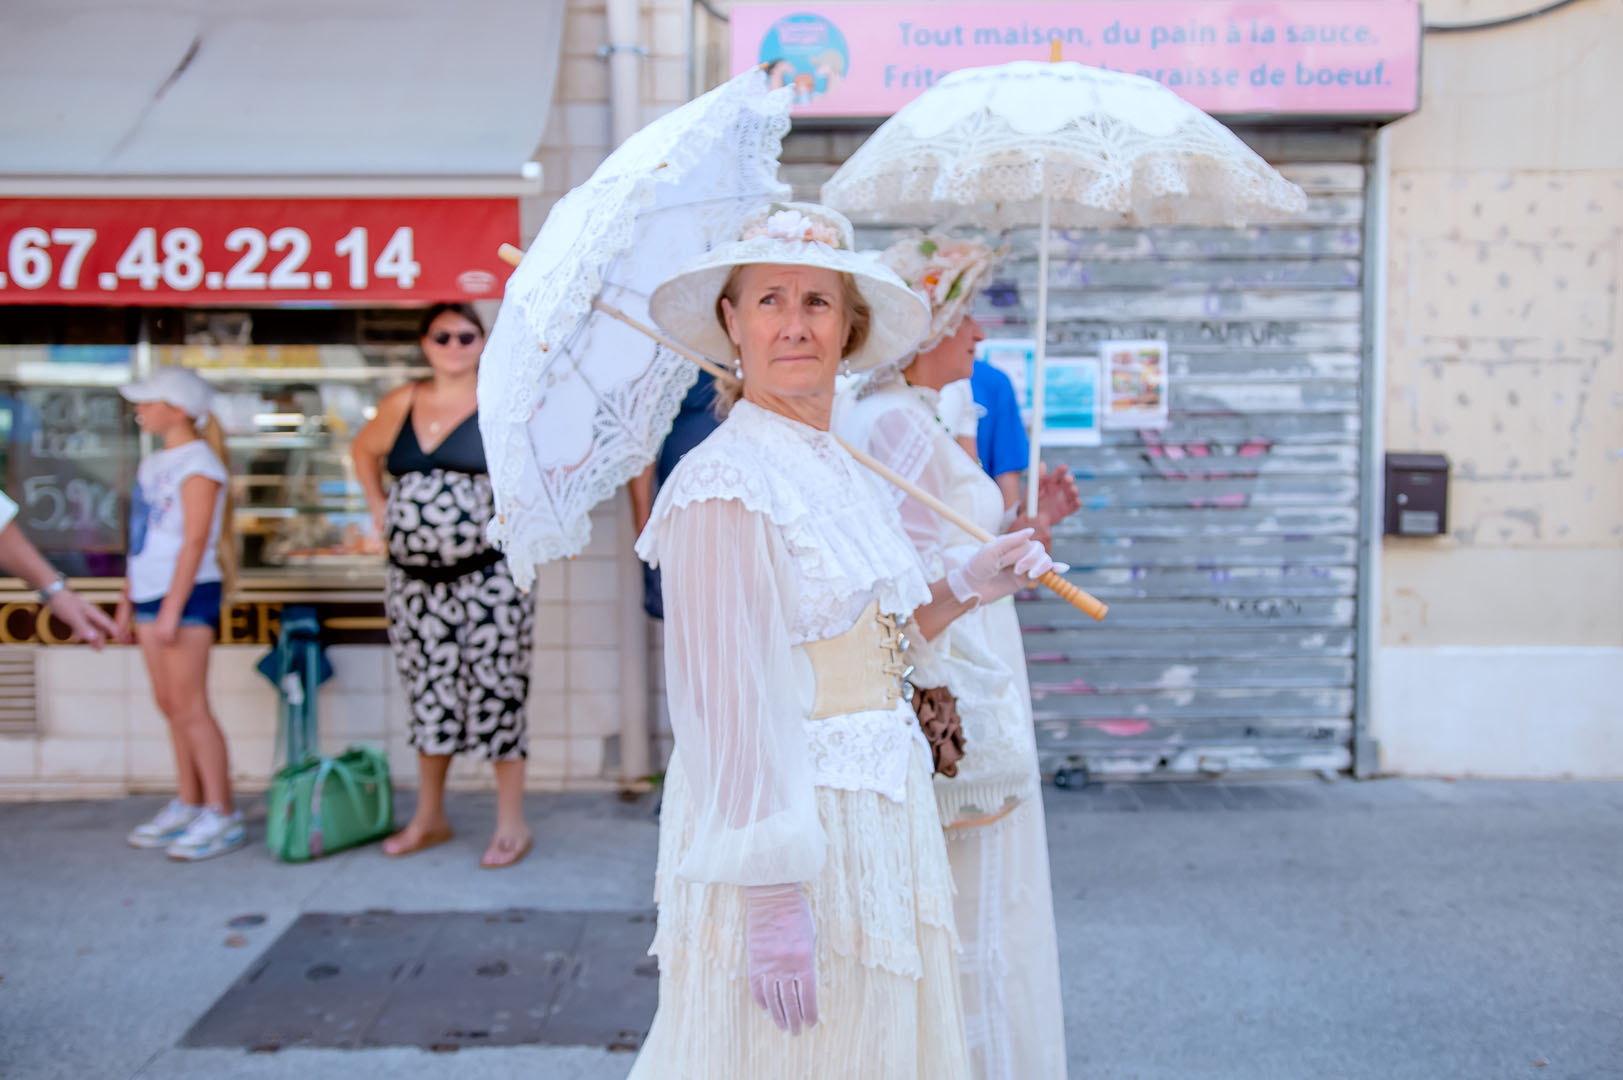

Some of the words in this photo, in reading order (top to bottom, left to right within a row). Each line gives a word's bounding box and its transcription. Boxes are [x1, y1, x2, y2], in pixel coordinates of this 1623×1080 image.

[899, 21, 964, 46] Tout
[973, 22, 1092, 47] maison,
[1102, 21, 1141, 45] du
[1151, 19, 1216, 50] pain
[1225, 17, 1243, 44] à
[1251, 20, 1276, 43] la
[1249, 61, 1286, 86] de
[1296, 60, 1392, 87] boeuf.
